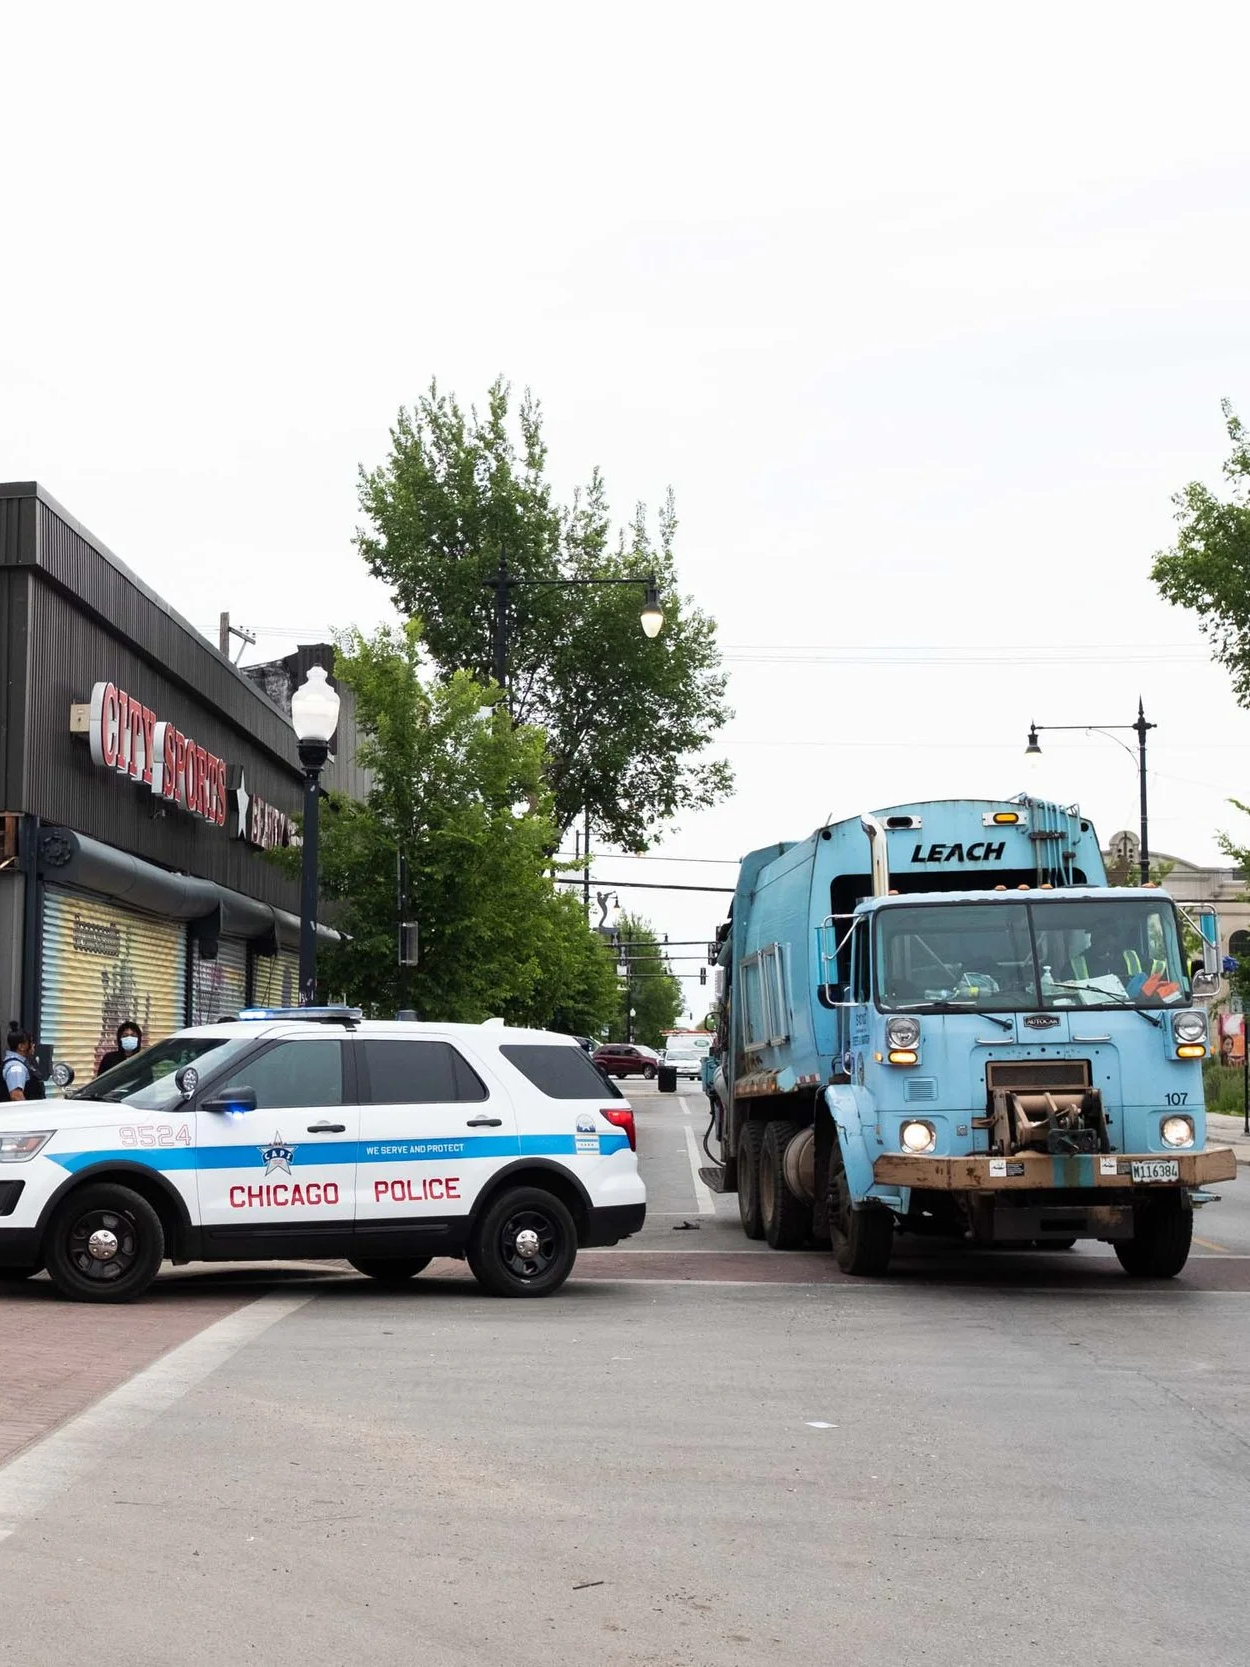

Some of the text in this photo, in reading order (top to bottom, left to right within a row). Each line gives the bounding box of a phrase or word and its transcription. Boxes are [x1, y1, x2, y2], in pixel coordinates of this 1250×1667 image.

[97, 681, 227, 828] CITY SPORTS
[910, 841, 1006, 863] LEACH
[1164, 1092, 1189, 1106] 107
[118, 1124, 192, 1148] 9524
[264, 1150, 292, 1160] CAPS
[366, 1143, 465, 1155] WE SERVE AND PROTECT
[229, 1177, 461, 1208] CHICAGO POLICE
